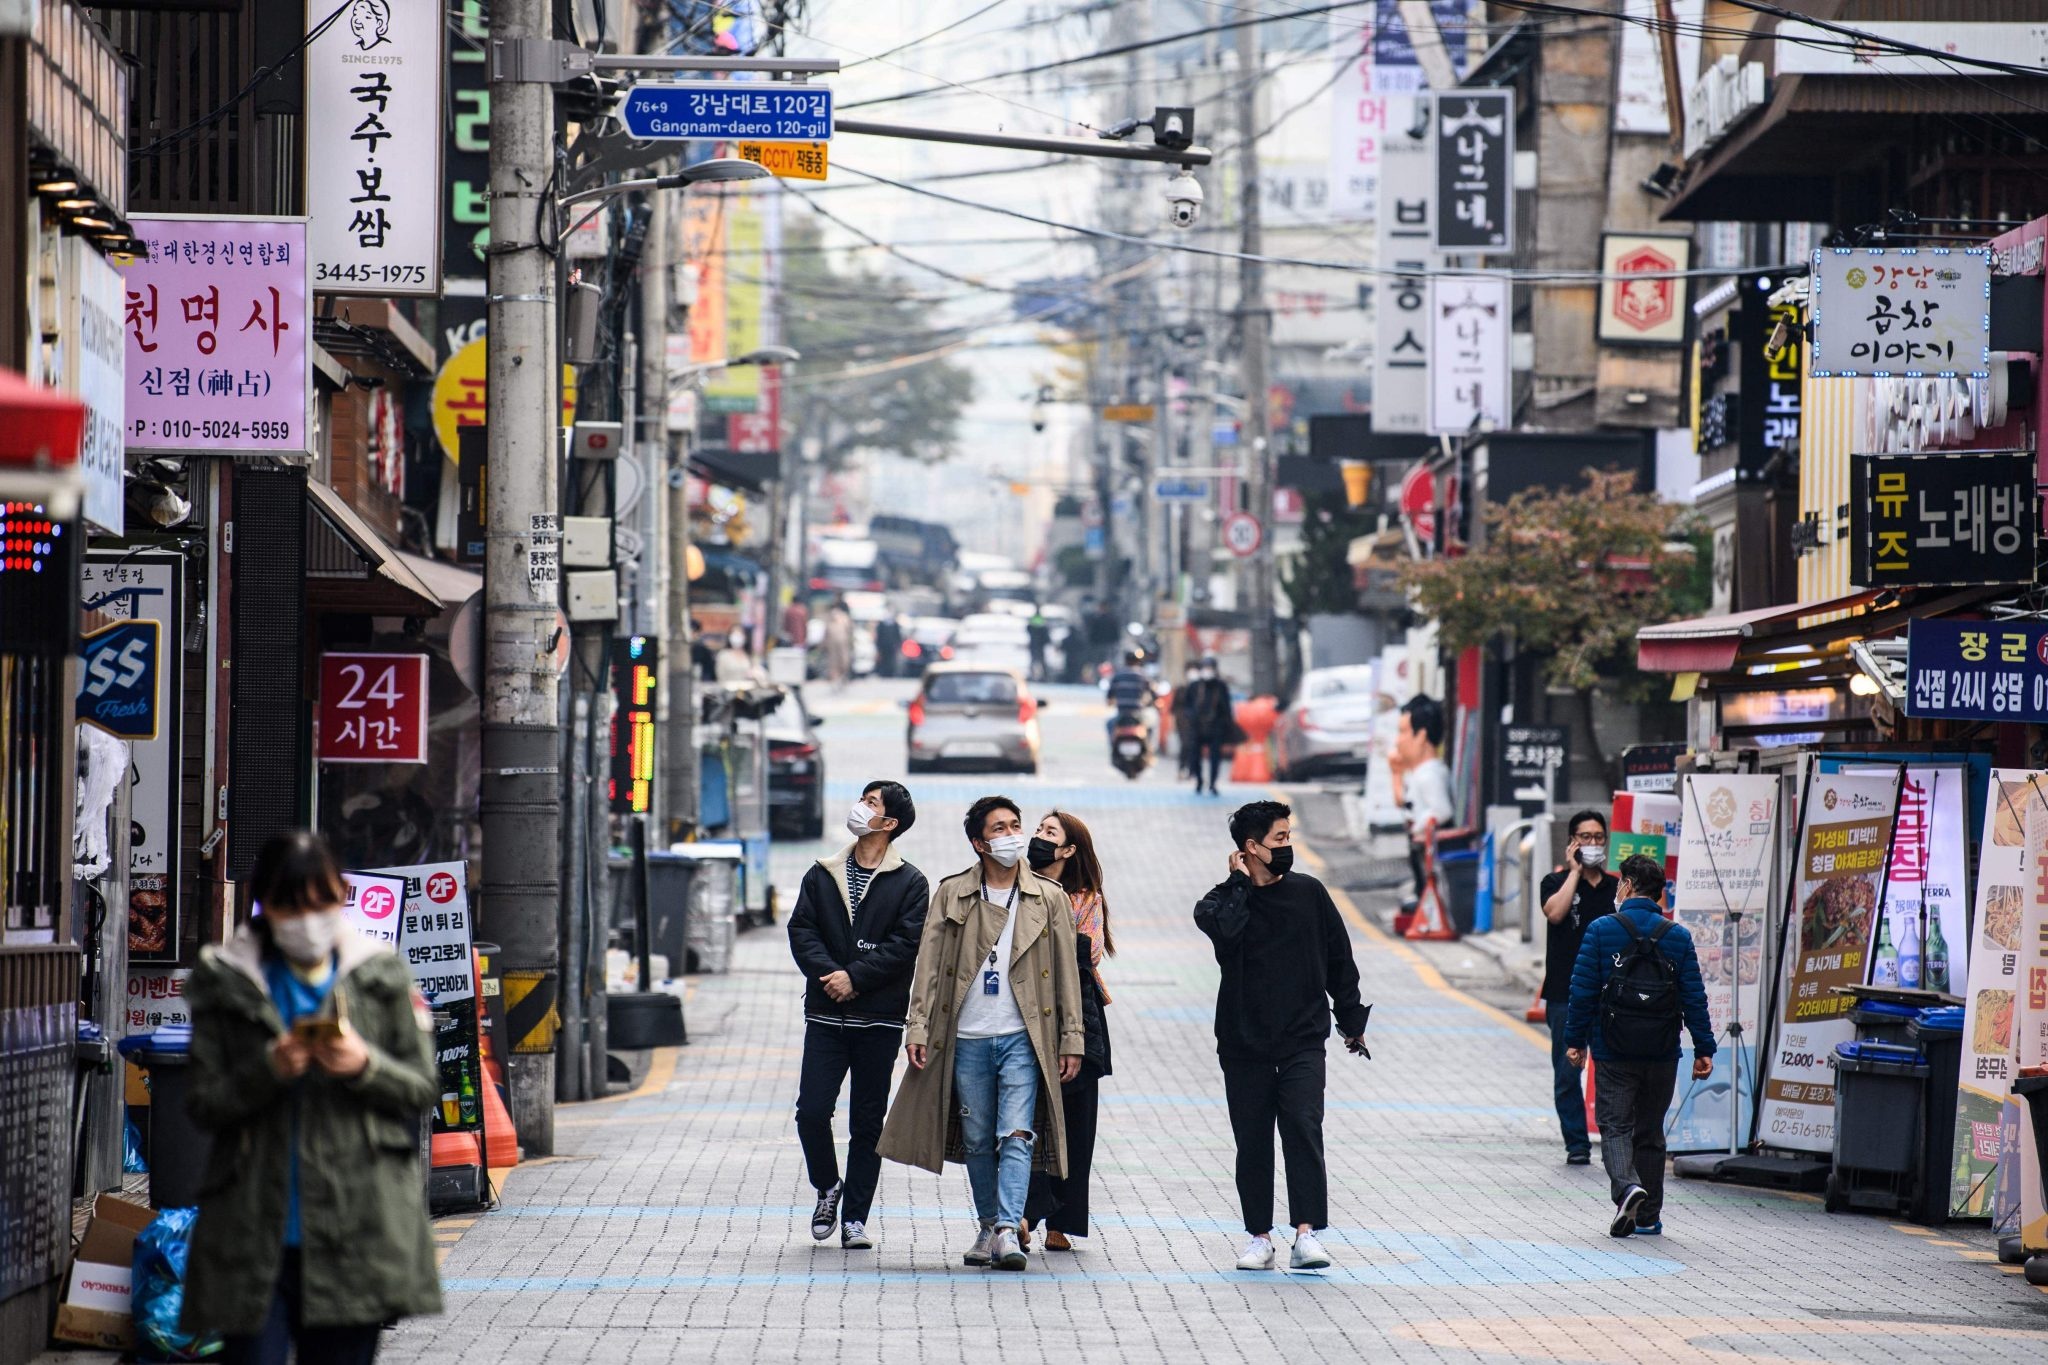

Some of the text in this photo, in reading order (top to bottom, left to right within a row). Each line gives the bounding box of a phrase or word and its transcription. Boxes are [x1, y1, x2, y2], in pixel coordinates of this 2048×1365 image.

[634, 101, 668, 113] 76 9
[689, 93, 826, 117] 강남대로120길
[650, 119, 826, 137] Gangnam-daero 120-gil
[763, 148, 795, 169] CCTV
[797, 150, 823, 174] 작동중
[1453, 131, 1489, 228] 나그네
[163, 240, 290, 267] 대한경신연합회
[316, 262, 426, 284] 3445-1975
[1872, 265, 1934, 290] 강남
[125, 283, 289, 358] 천명사
[1866, 295, 1940, 336] 곱창
[1850, 340, 1954, 365] 이야기
[162, 420, 290, 440] 010-5024-5959
[1875, 472, 2025, 570] 뮤즈 노래방
[1959, 631, 2027, 663] 장군
[336, 663, 405, 710] 24
[1915, 668, 1946, 709] 신점
[1951, 671, 1987, 711] 24시
[1991, 672, 2024, 712] 상담
[95, 698, 149, 718] Fresh
[334, 715, 402, 750] 시간
[1813, 826, 1879, 849] 가성비대박!!
[1812, 848, 1885, 874] 청담야채곱창!!
[430, 878, 453, 898] 2F
[364, 891, 391, 913] 2F
[408, 943, 466, 964] 한우고로케
[1805, 951, 1861, 974] 출시기념 할인
[1799, 982, 1818, 998] 하루
[1795, 998, 1838, 1018] 20테이블
[1785, 1034, 1807, 1048] 1인분
[442, 1044, 469, 1063] 100%
[1780, 1084, 1802, 1100] 배달
